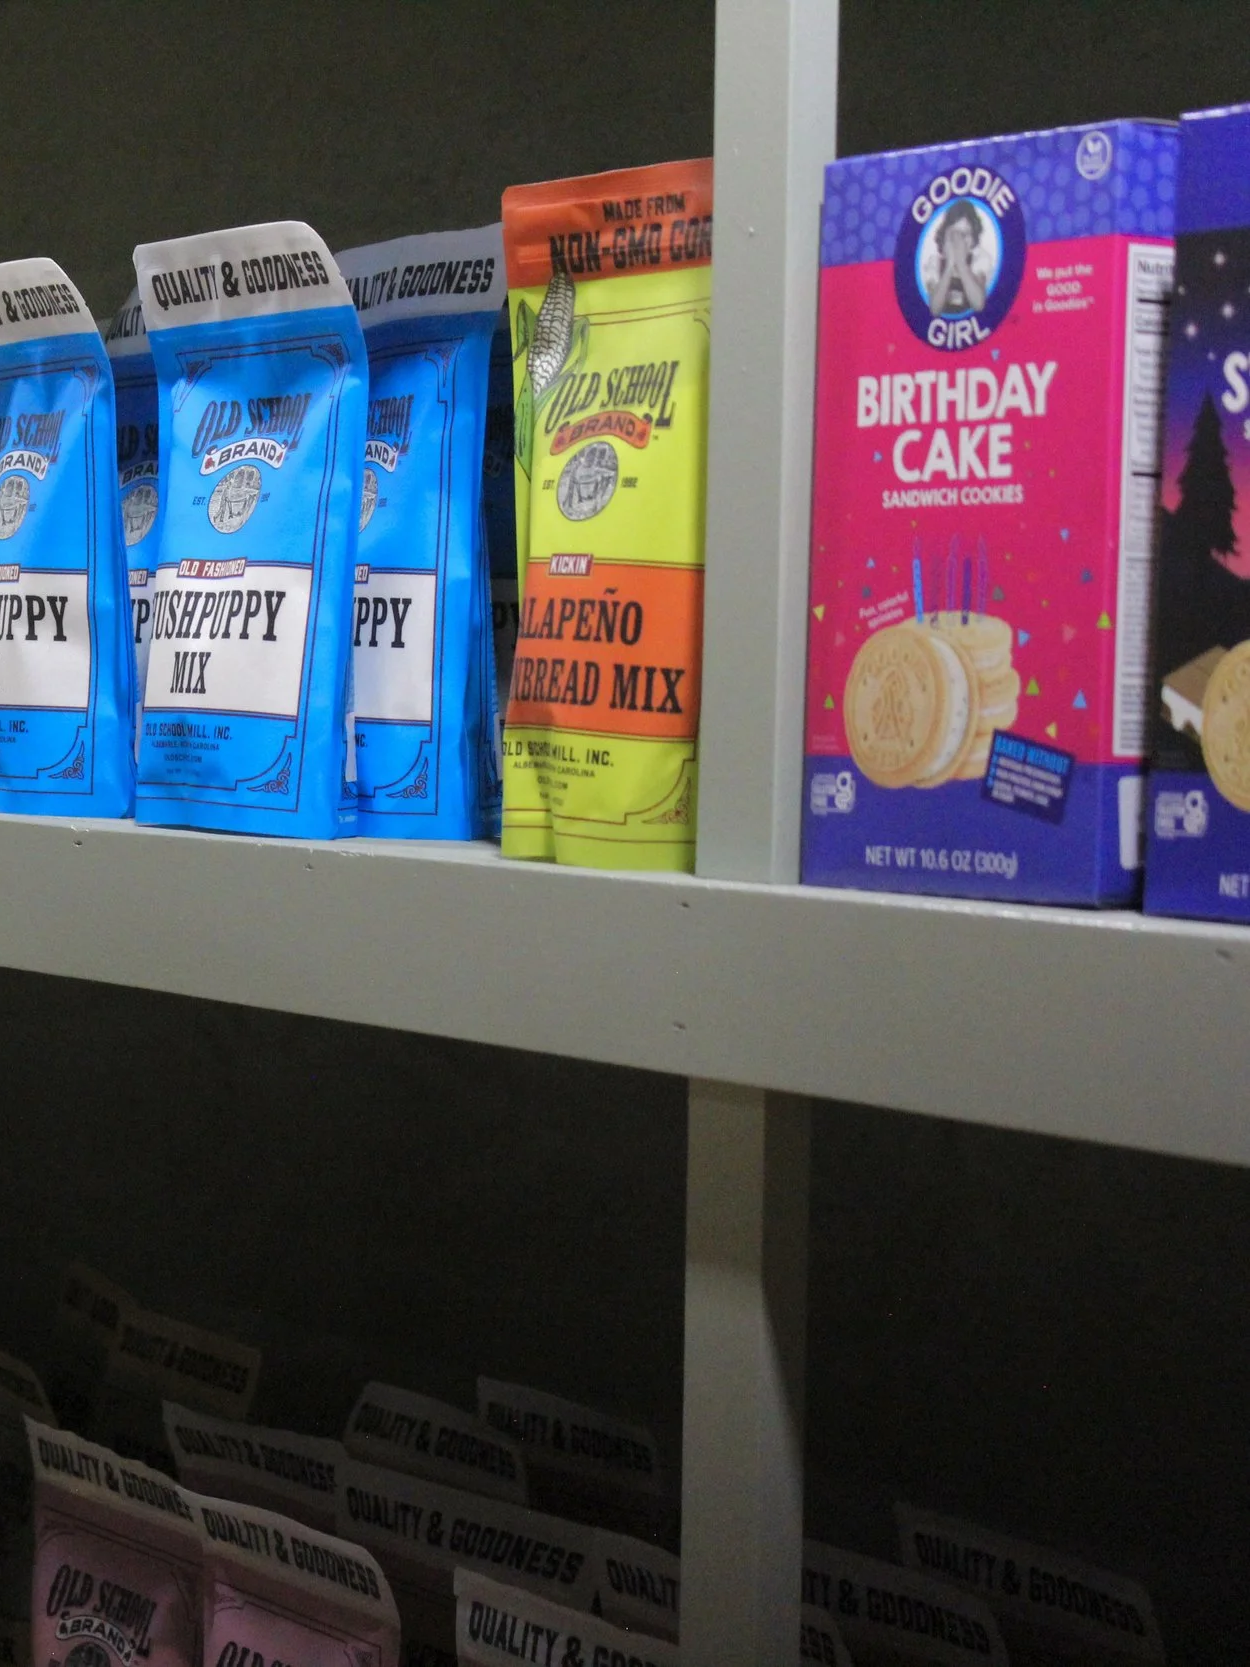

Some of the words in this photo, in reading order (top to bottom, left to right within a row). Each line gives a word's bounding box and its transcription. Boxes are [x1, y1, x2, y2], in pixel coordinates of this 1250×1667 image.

[602, 197, 643, 223] MADE
[645, 195, 687, 219] FROM
[912, 167, 1015, 224] GOODIE
[669, 215, 713, 262] COR
[152, 264, 220, 311] QUALITY
[220, 261, 242, 298] &
[241, 250, 330, 295] GOODNESS
[385, 266, 399, 303] &
[397, 257, 496, 299] GOODNESS
[2, 290, 21, 323] &
[14, 283, 81, 321] GOODNESS
[927, 316, 991, 349] GIRL
[544, 371, 602, 435] OLD
[601, 359, 680, 430] SCHOOL
[856, 360, 1060, 428] BIRTHDAY
[191, 399, 243, 458] OLD
[569, 415, 636, 443] BRAND
[121, 460, 159, 486] BRA
[216, 441, 278, 465] BRAND
[364, 440, 391, 464] AND
[892, 423, 1014, 484] CAKE
[881, 486, 959, 509] SANDWICH
[960, 484, 1025, 506] COOKIES
[178, 559, 199, 577] OLD
[201, 558, 246, 578] FASHIONED
[150, 589, 287, 642] USHPUPPY
[170, 650, 212, 694] MIX
[609, 663, 686, 715] MIX
[8, 719, 29, 734] INC.
[158, 722, 187, 738] SCHOOL
[213, 725, 233, 741] INC.
[585, 748, 615, 768] INC.
[865, 845, 892, 867] NET
[894, 847, 917, 868] WT
[920, 848, 949, 871] 10.6
[951, 850, 972, 873] OZ
[1218, 872, 1250, 898] NET
[37, 1437, 101, 1490] QUALITY
[103, 1461, 120, 1493] &
[200, 1506, 271, 1558] QUALITY
[272, 1529, 290, 1564] &
[289, 1535, 383, 1601] GOODNESS
[345, 1485, 424, 1540] QUALITY
[425, 1509, 445, 1548] &
[449, 1517, 586, 1586] GOODNESS
[46, 1563, 95, 1619] OLD
[605, 1557, 679, 1614] QUALIT
[68, 1618, 128, 1655] BRAND
[468, 1600, 558, 1667] QUALITY
